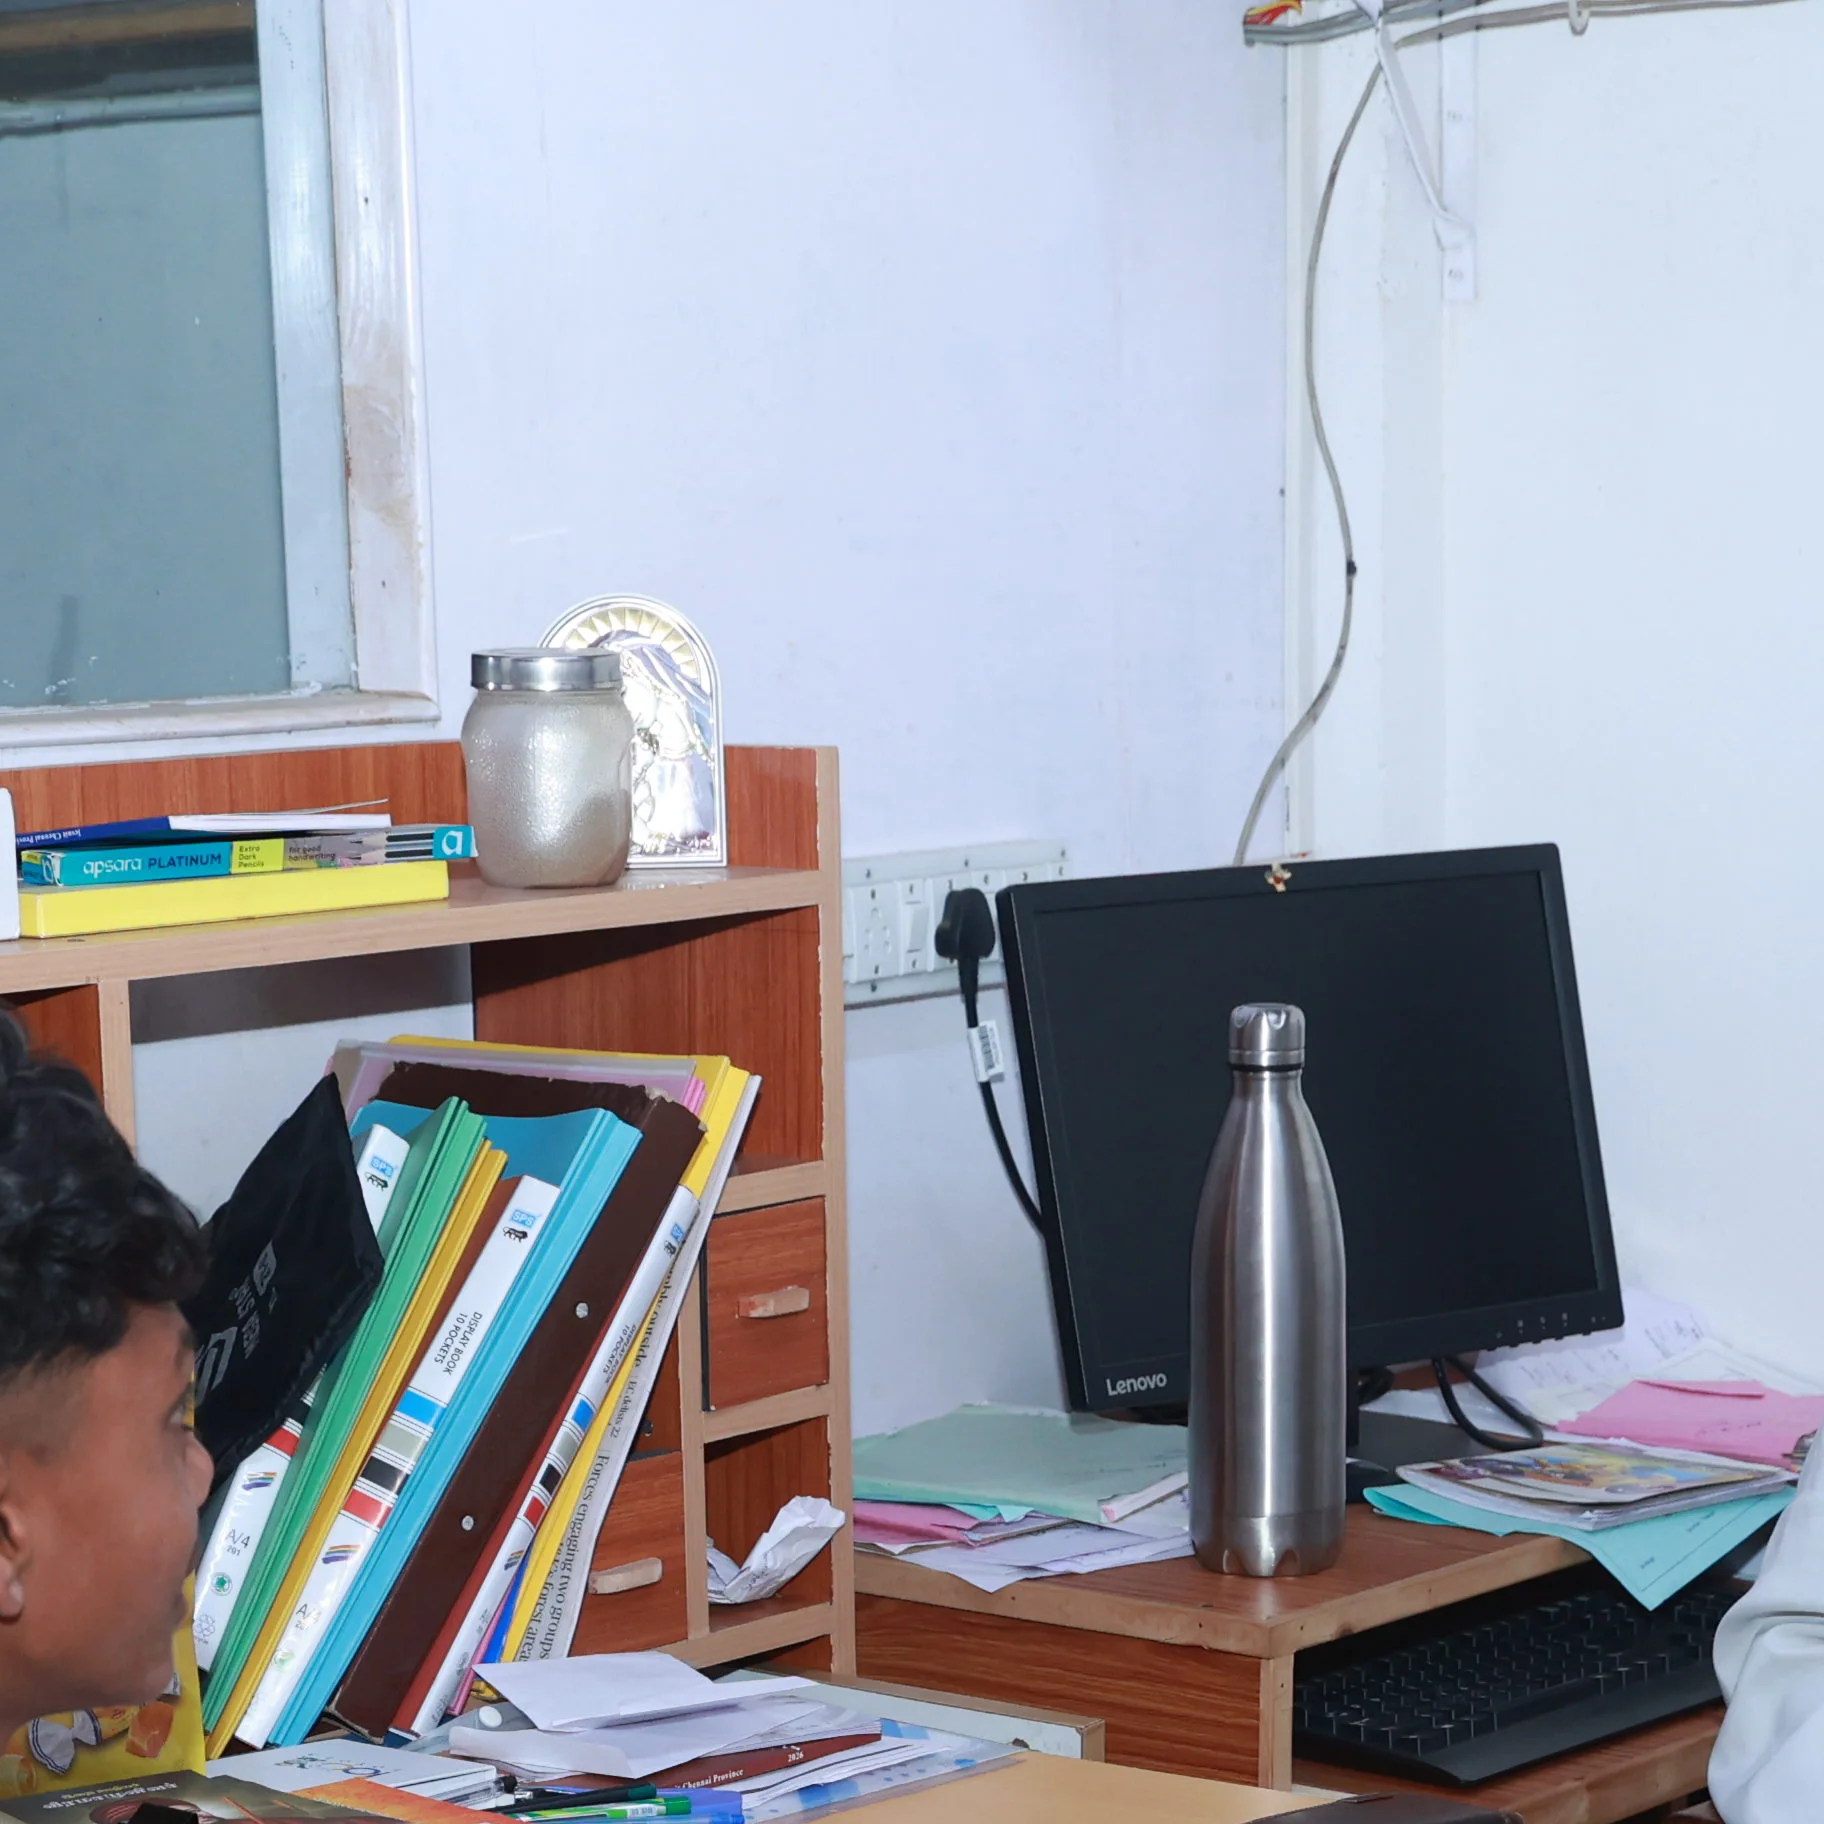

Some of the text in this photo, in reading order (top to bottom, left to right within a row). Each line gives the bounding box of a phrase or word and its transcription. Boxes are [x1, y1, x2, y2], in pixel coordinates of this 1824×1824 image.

[238, 845, 261, 853] Extra
[238, 853, 257, 861] Dark
[83, 852, 222, 878] apsara PLATINUM
[238, 860, 265, 869] Pencils
[370, 1156, 396, 1178] SPS
[511, 1209, 537, 1228] SPS
[434, 1314, 469, 1365] 10 POCKETS
[442, 1311, 482, 1376] DISPLAY BOOK
[602, 1335, 626, 1375] POCKETS
[1106, 1373, 1168, 1396] Lenovo
[225, 1529, 251, 1549] A/4
[539, 1453, 610, 1661] Forces engaging two groups
[787, 1751, 804, 1763] 2026
[713, 1768, 744, 1783] Province
